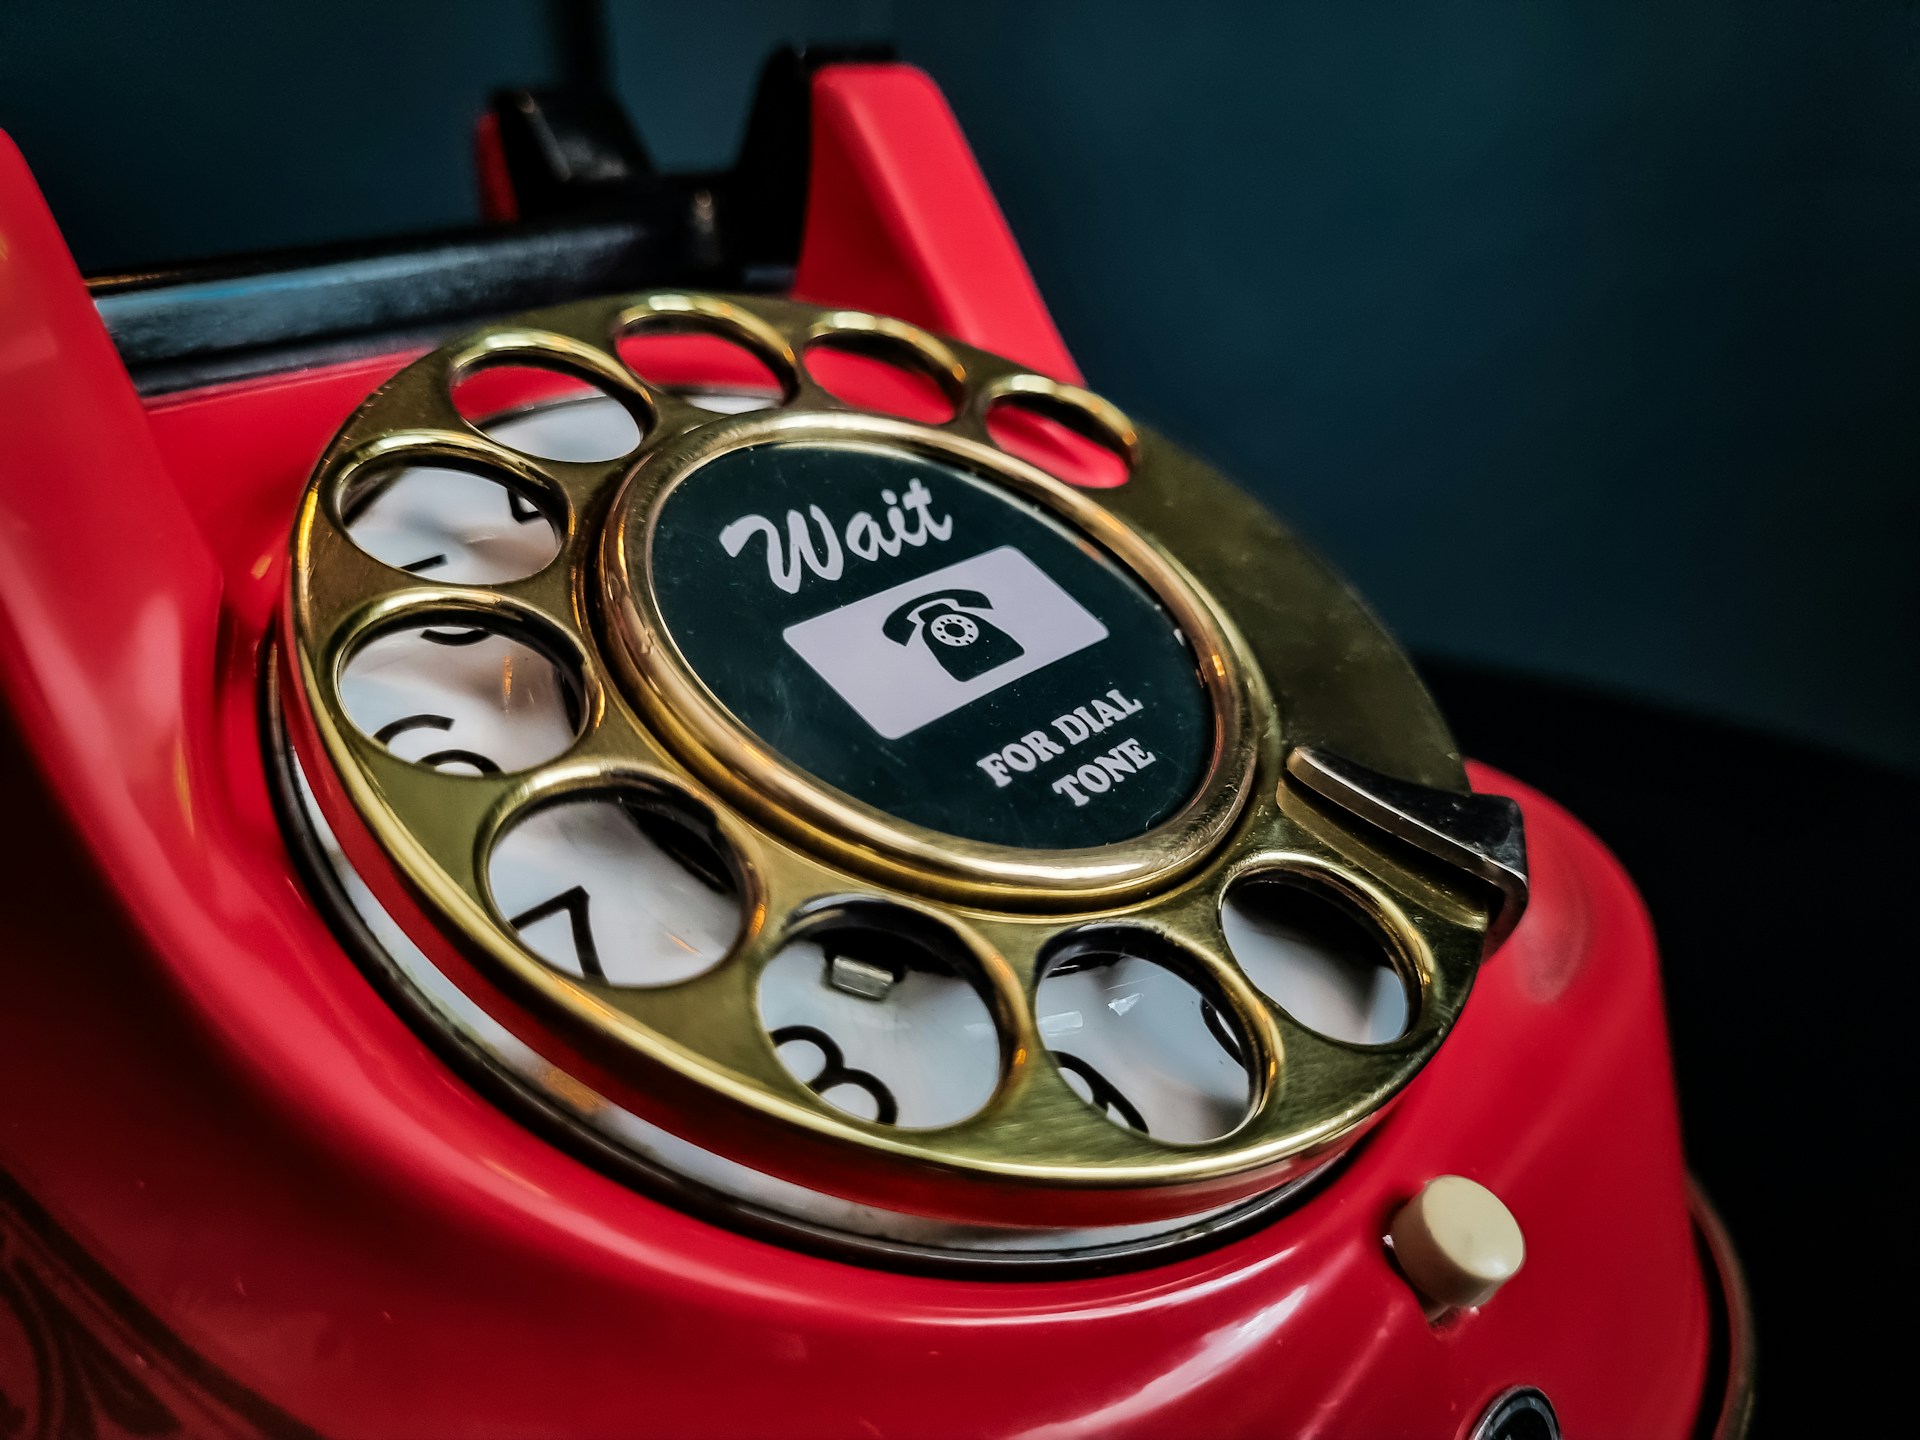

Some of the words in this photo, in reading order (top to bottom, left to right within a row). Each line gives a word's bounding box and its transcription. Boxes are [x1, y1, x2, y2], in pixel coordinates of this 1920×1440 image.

[720, 478, 952, 593] Wait
[977, 729, 1064, 787] FOR
[1052, 690, 1143, 745] DIAL
[1052, 738, 1156, 806] TONE
